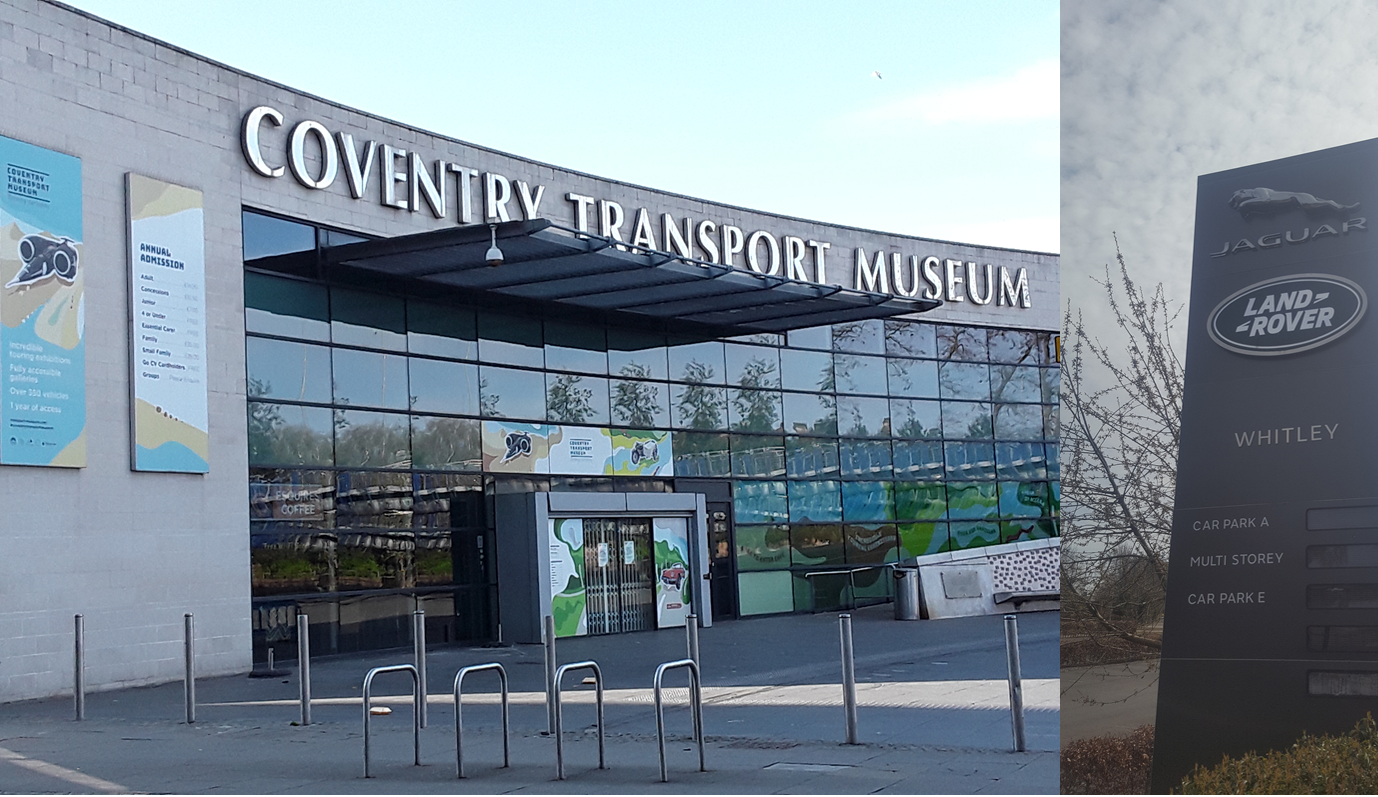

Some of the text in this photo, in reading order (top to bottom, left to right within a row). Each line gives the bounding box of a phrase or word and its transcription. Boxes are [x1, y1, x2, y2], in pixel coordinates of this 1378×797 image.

[7, 167, 44, 182] COVENTRY
[8, 175, 50, 191] TRANSPORT
[8, 183, 38, 196] MUSEUM
[241, 105, 1032, 309] COVENTRY TRANSPORT MUSEUM
[1210, 216, 1368, 258] JAGUAR
[140, 242, 172, 257] ANNUAL
[140, 253, 185, 271] ADMISSION
[1243, 289, 1314, 317] LAND
[1249, 306, 1335, 337] ROVER
[9, 386, 27, 396] Over
[15, 403, 30, 411] year
[40, 405, 62, 413] access
[1234, 423, 1339, 447] WHITLEY
[281, 503, 316, 515] COFFEE
[1192, 516, 1270, 531] CAR PARK A
[1190, 553, 1284, 568] MULTI STOREY
[1187, 591, 1266, 606] CAR PARK E
